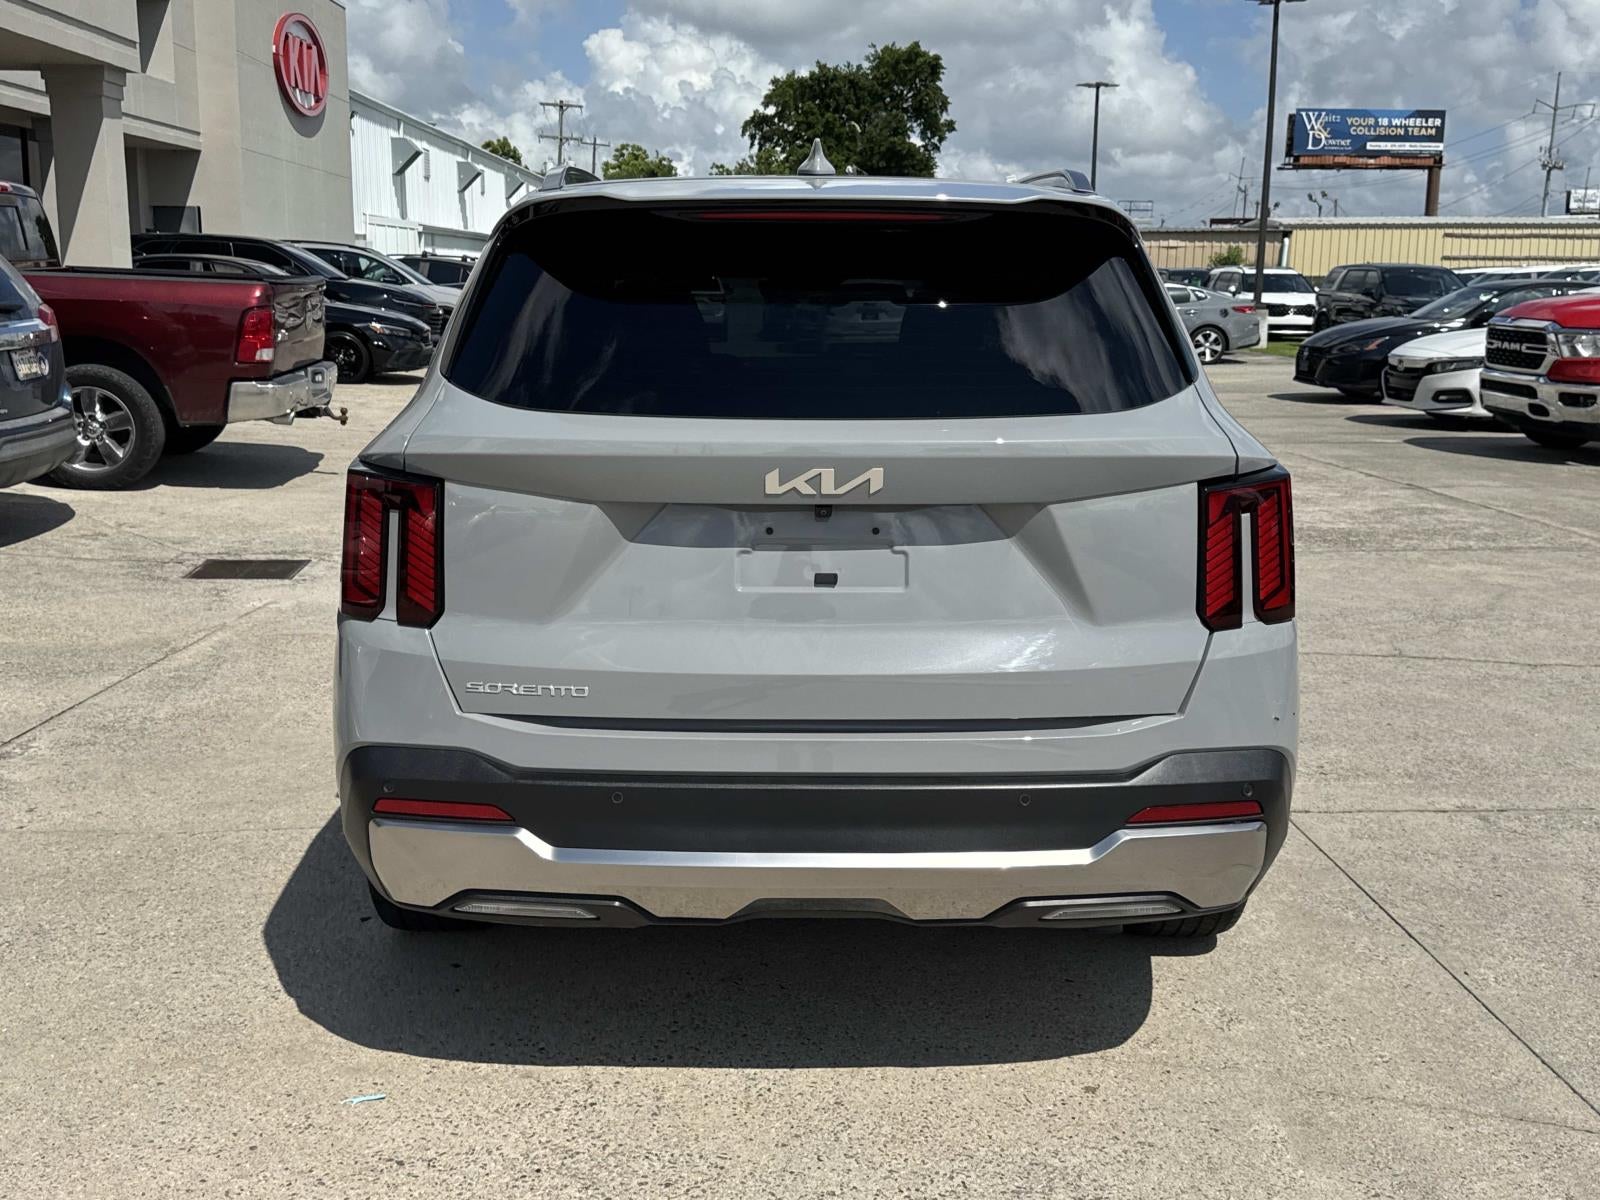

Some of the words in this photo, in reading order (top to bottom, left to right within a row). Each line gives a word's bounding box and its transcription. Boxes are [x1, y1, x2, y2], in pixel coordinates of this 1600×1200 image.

[284, 31, 323, 101] KIA
[1346, 117, 1375, 126] YOUR
[1378, 117, 1389, 126] 18
[1391, 117, 1442, 127] WHEELER
[1350, 126, 1405, 136] COLLISION
[1407, 127, 1436, 136] TEAM
[1307, 130, 1352, 150] Downer
[1496, 340, 1520, 351] RAM
[765, 467, 884, 495] KIA
[465, 681, 589, 697] SORENTO
